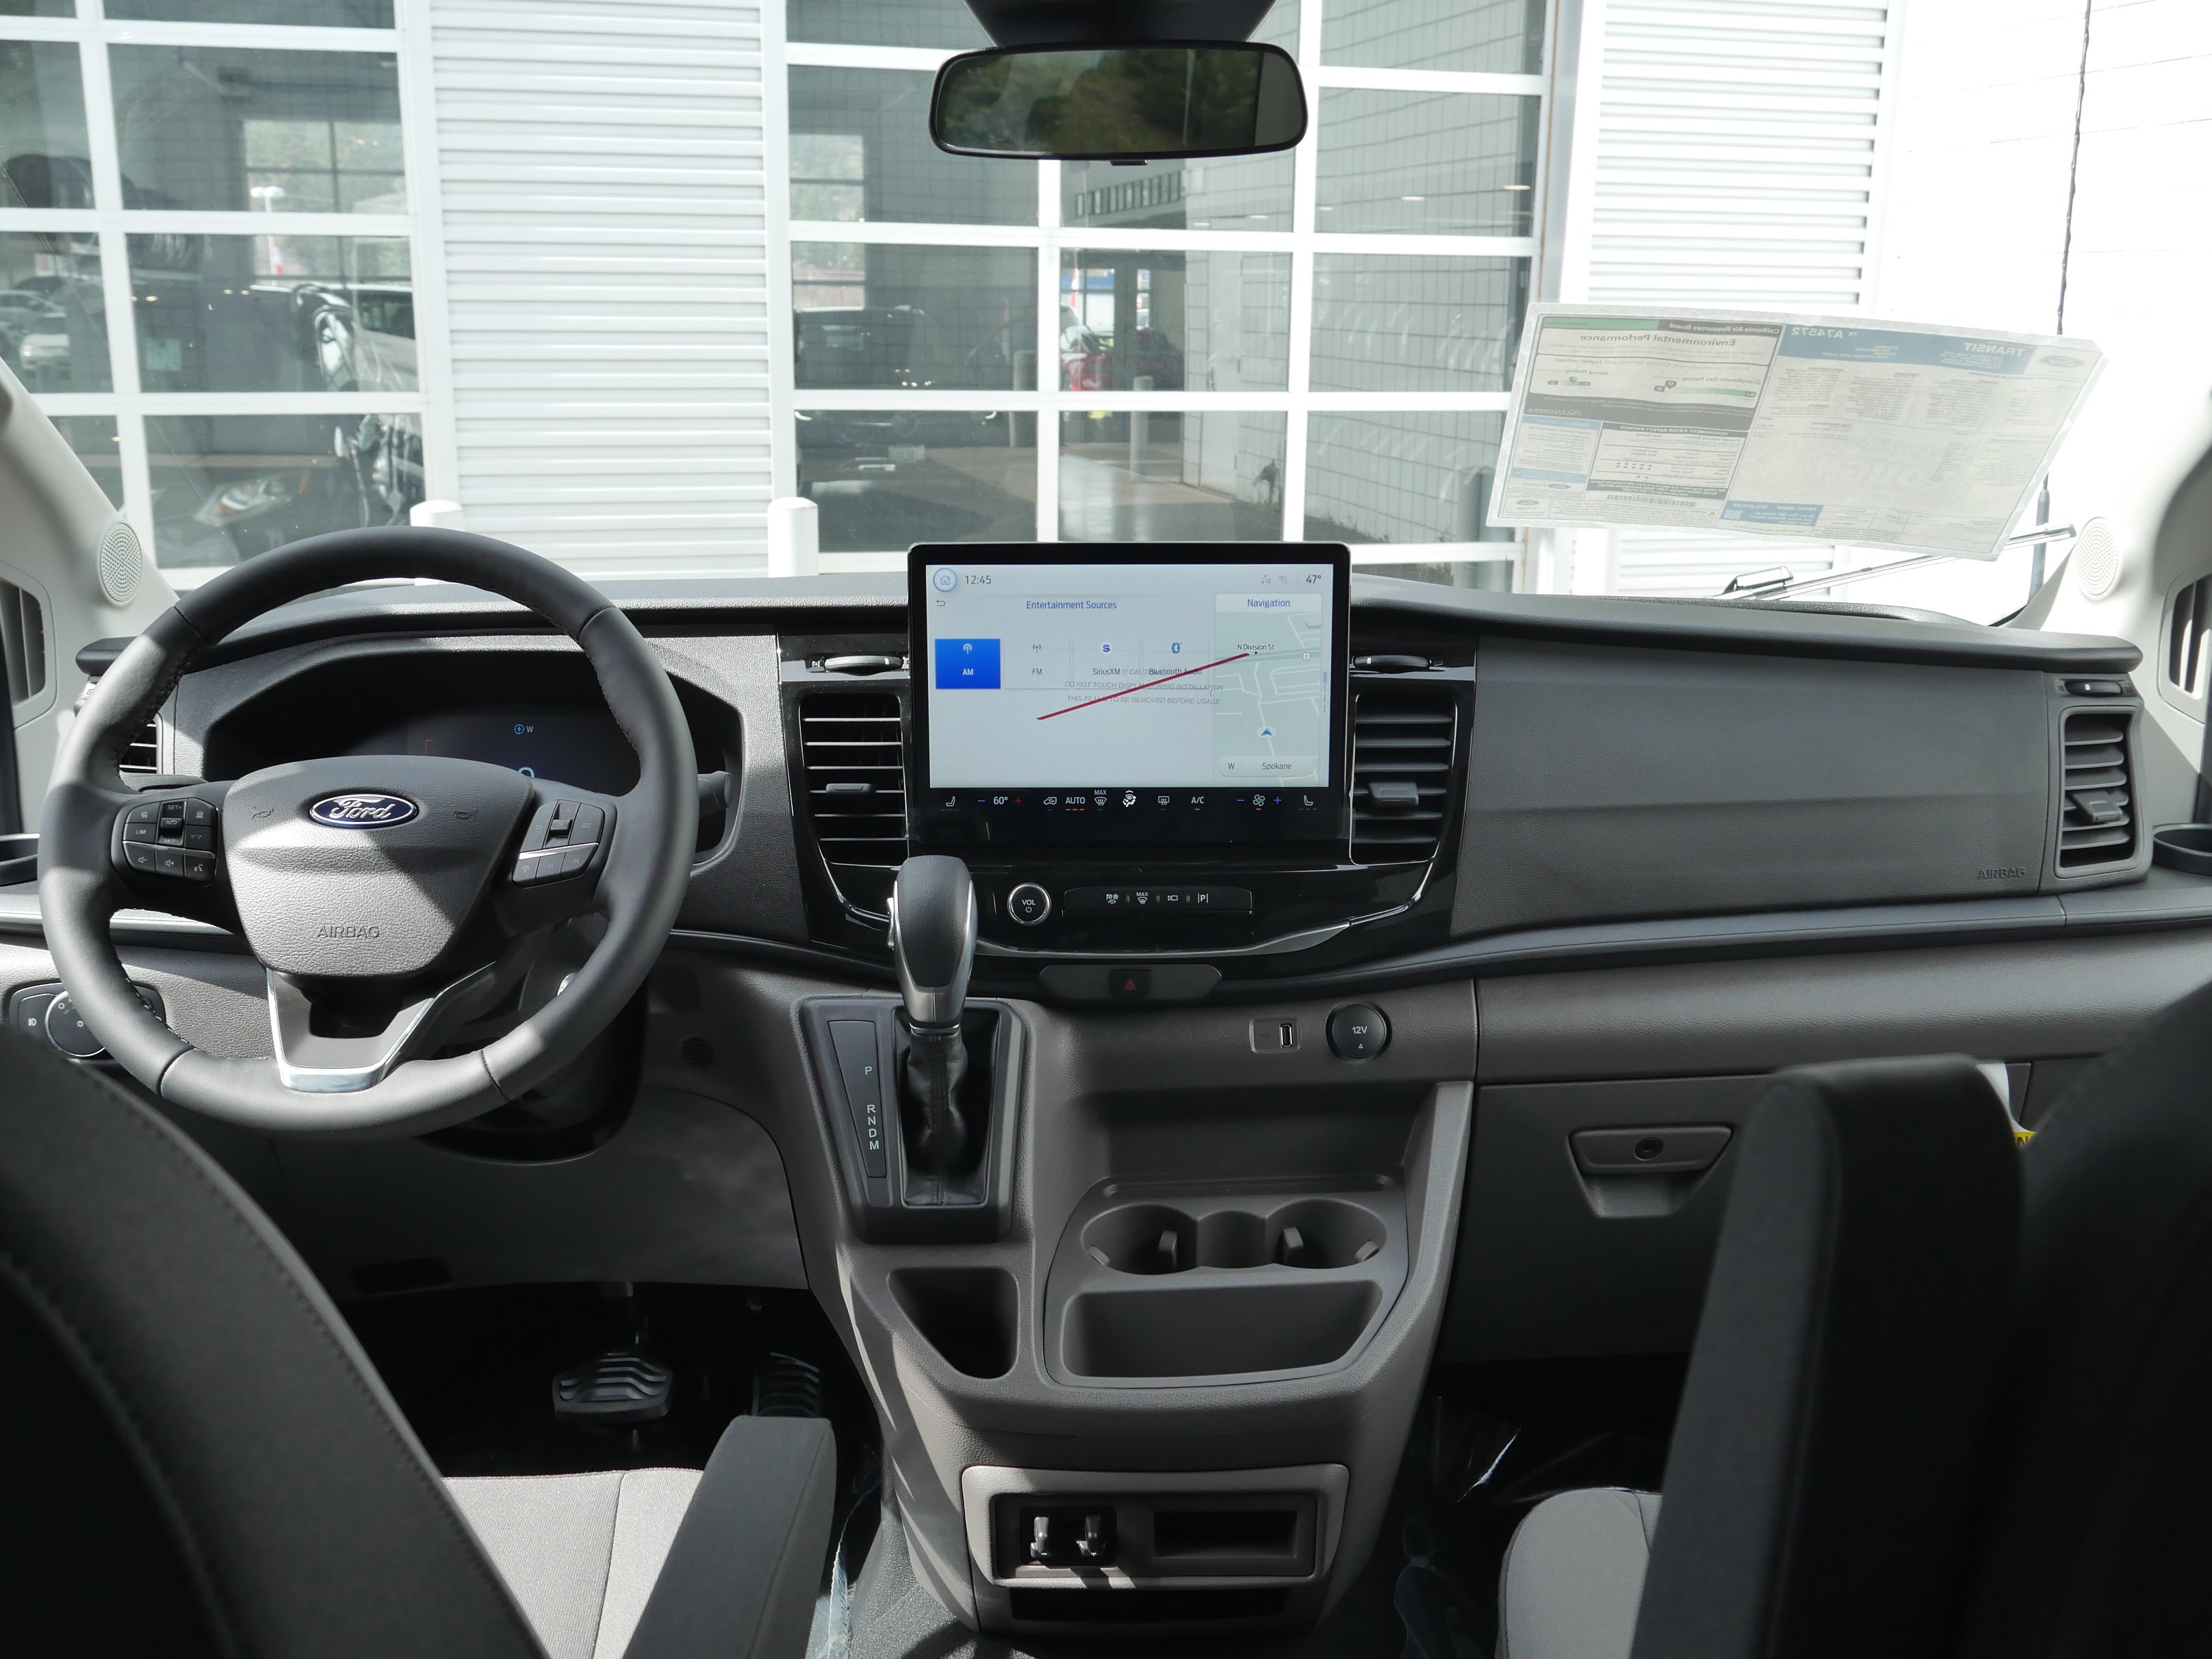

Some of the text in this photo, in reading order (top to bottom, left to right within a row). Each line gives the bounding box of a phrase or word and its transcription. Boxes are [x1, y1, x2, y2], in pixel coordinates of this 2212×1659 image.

[965, 575, 992, 584] 12:45
[1306, 575, 1322, 584] 47°
[1026, 601, 1117, 609] Entertainment Sources
[1247, 599, 1291, 608] Navigation
[1262, 762, 1292, 771] Spokane
[993, 796, 1008, 805] 60°
[1191, 796, 1205, 804] A/C
[329, 798, 396, 819] Ford
[1978, 866, 2026, 879] AIRBAG
[317, 925, 380, 938] AIRBAG
[1352, 1026, 1367, 1034] 12V
[864, 1066, 873, 1075] P
[867, 1104, 876, 1114] R
[868, 1116, 877, 1125] N
[869, 1128, 877, 1137] D
[869, 1140, 879, 1150] M
